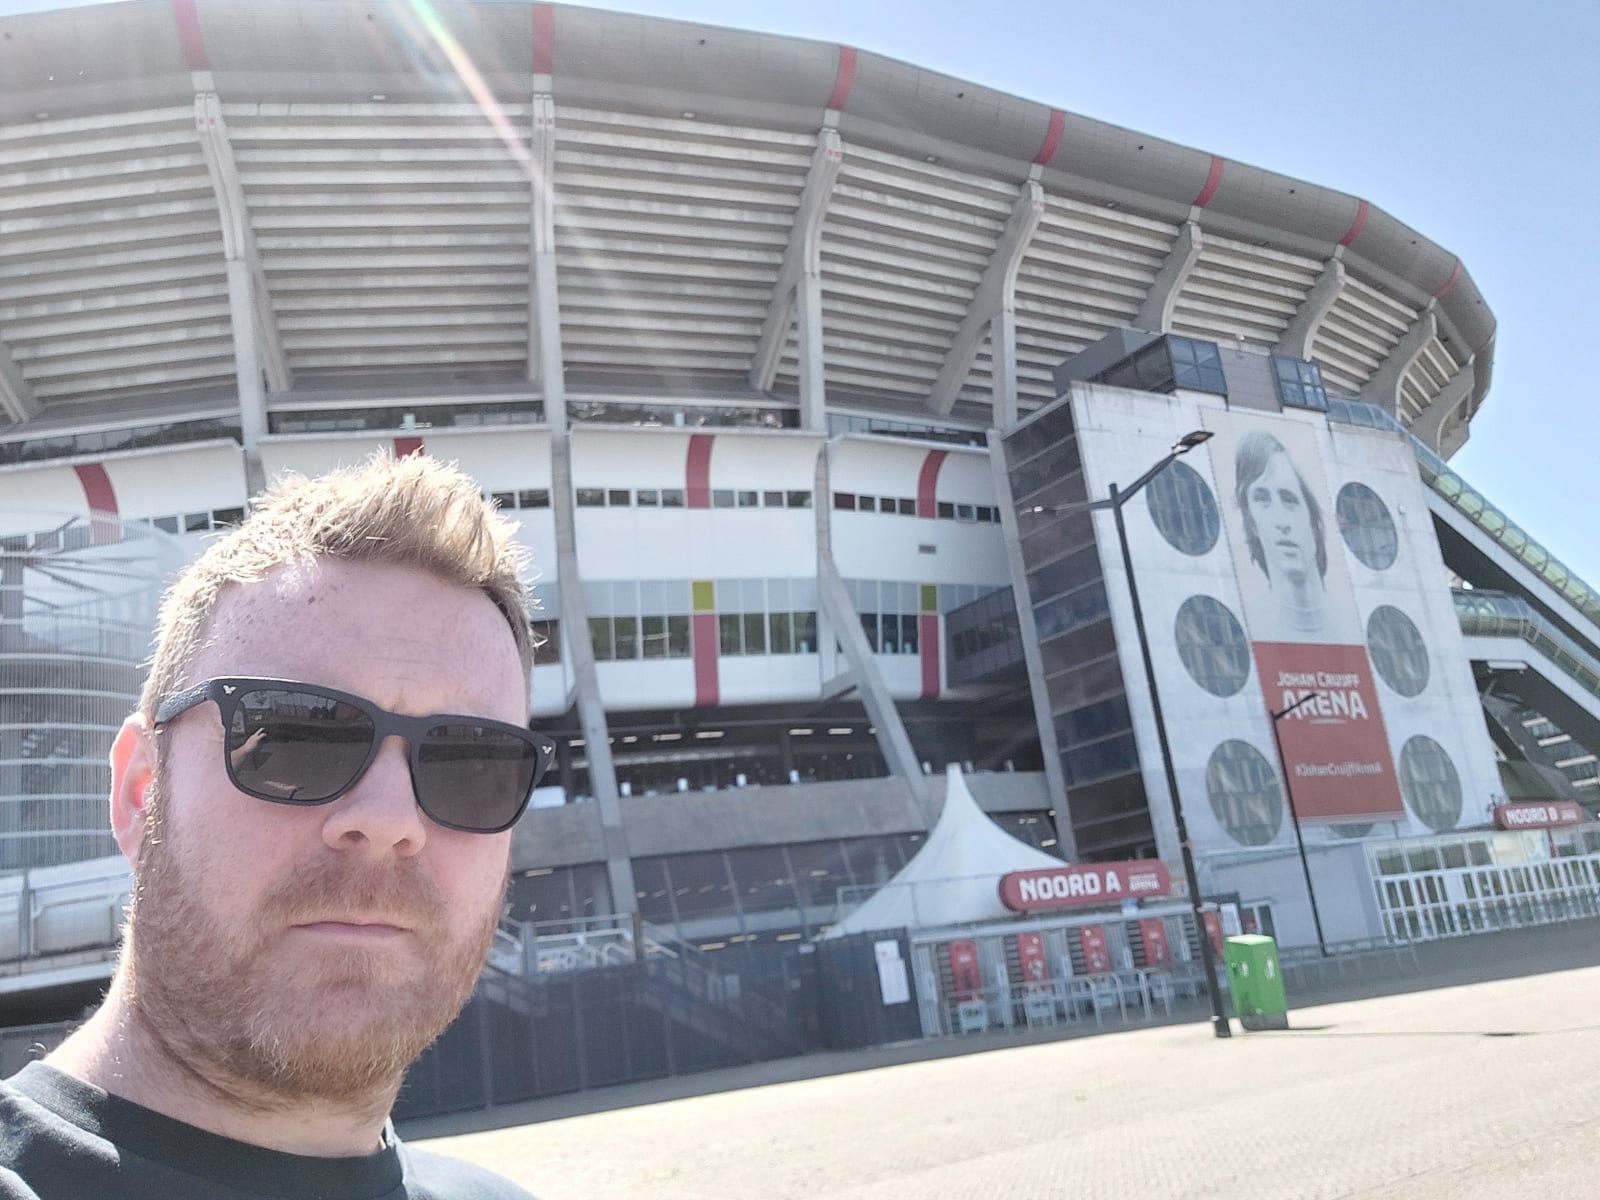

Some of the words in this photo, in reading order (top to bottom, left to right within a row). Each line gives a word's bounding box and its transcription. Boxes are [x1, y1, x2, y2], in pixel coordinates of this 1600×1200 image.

[1277, 672, 1316, 687] JOHAN
[1282, 689, 1368, 719] ARENA
[1505, 807, 1548, 825] NOORD
[1019, 872, 1101, 902] NOORD
[1106, 870, 1121, 893] A
